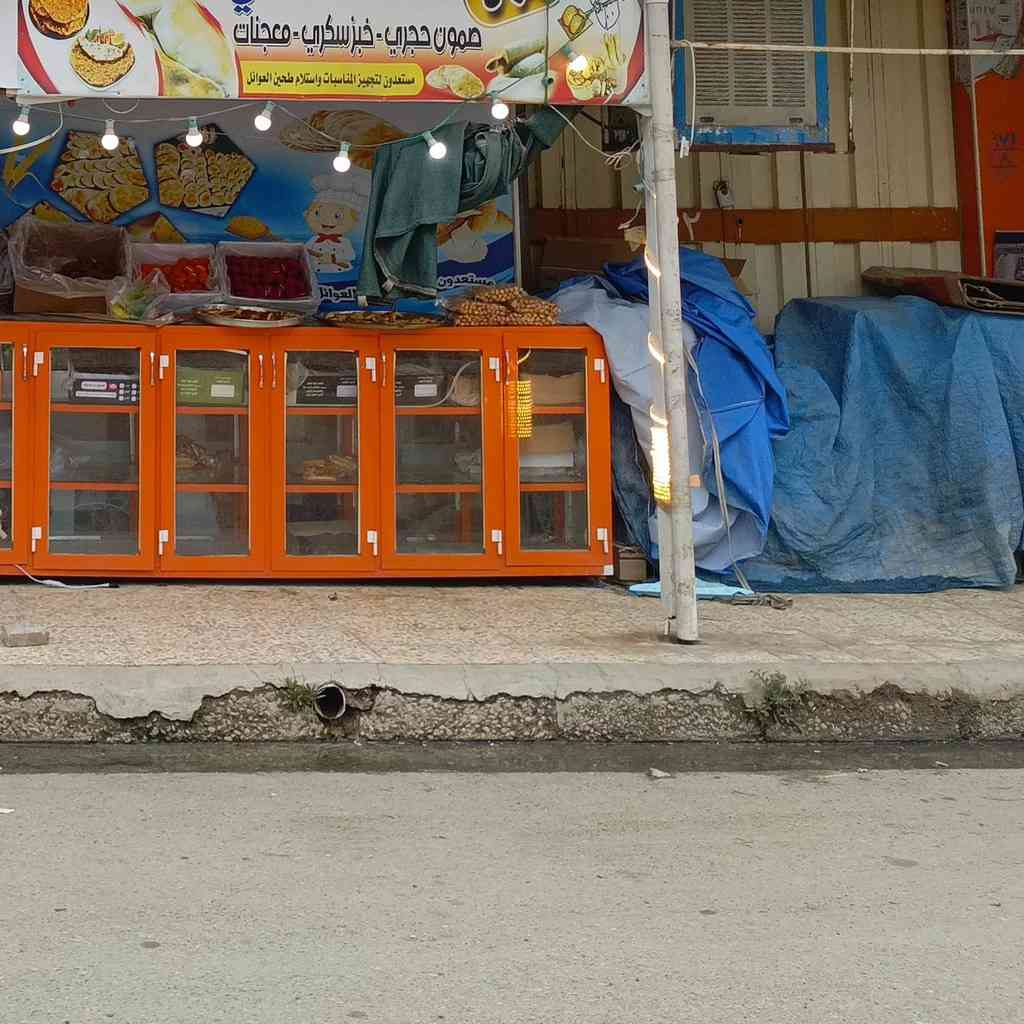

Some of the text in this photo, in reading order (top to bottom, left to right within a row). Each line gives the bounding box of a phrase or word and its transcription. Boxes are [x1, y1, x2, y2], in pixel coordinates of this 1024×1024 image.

[233, 15, 291, 56] معجنات
[384, 25, 433, 58] حجري
[433, 26, 483, 58] صمون
[438, 273, 497, 291] مستعدون
